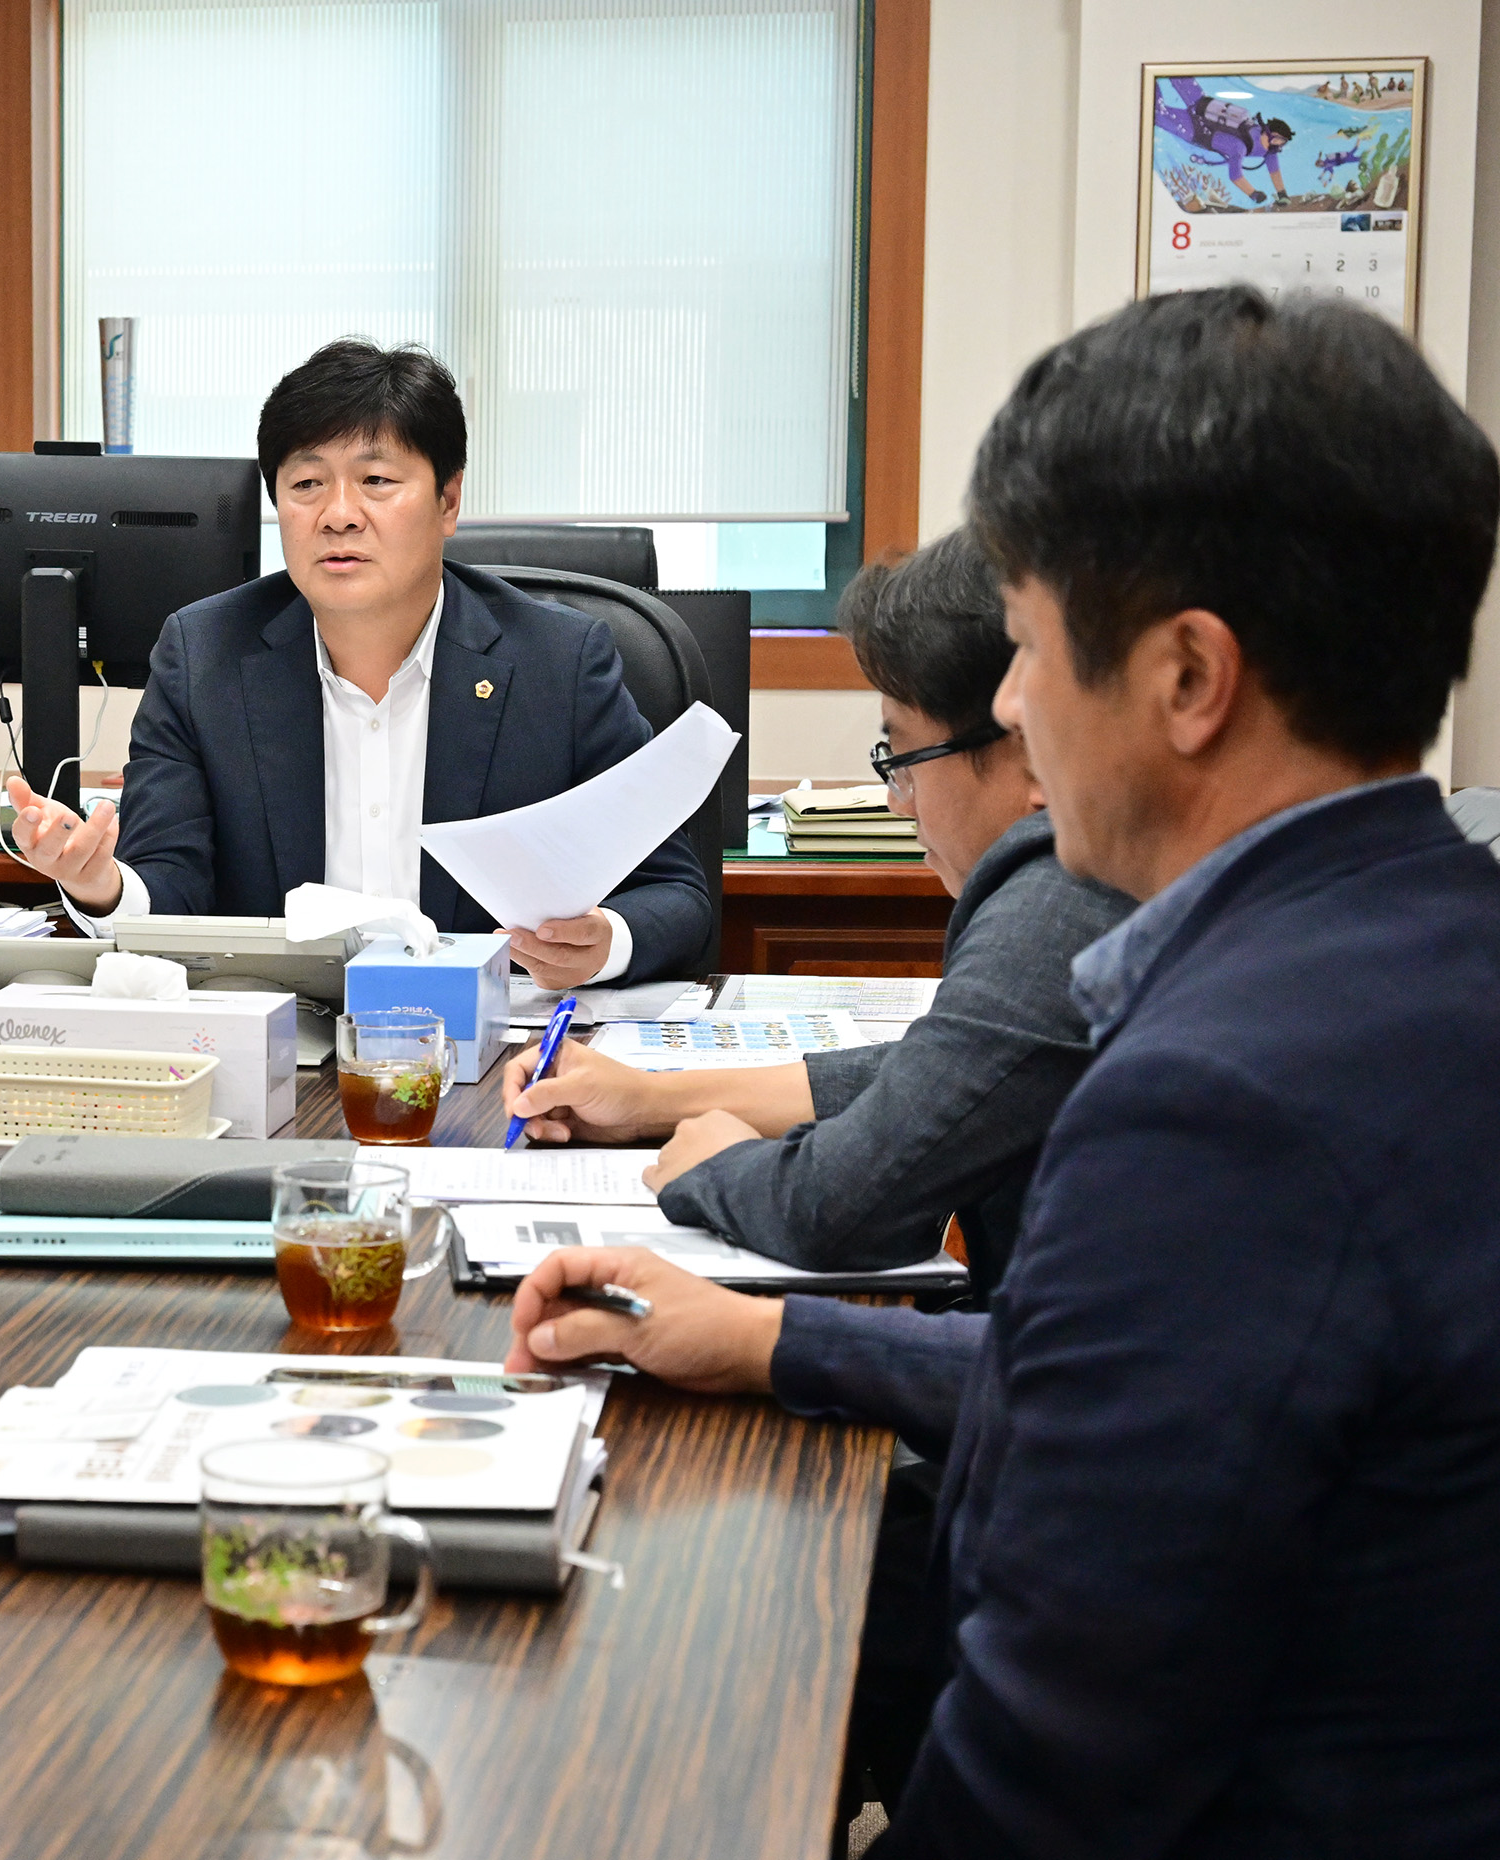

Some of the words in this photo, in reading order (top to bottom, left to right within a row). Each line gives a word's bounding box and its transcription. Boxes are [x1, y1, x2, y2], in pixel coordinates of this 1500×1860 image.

[1172, 221, 1191, 250] 8
[1305, 260, 1311, 272] 1
[1336, 260, 1345, 272] 2
[1369, 259, 1378, 272] 3
[1271, 287, 1279, 299] 7
[1335, 286, 1344, 298] 9
[1365, 286, 1380, 298] 10
[26, 511, 98, 524] TREEM
